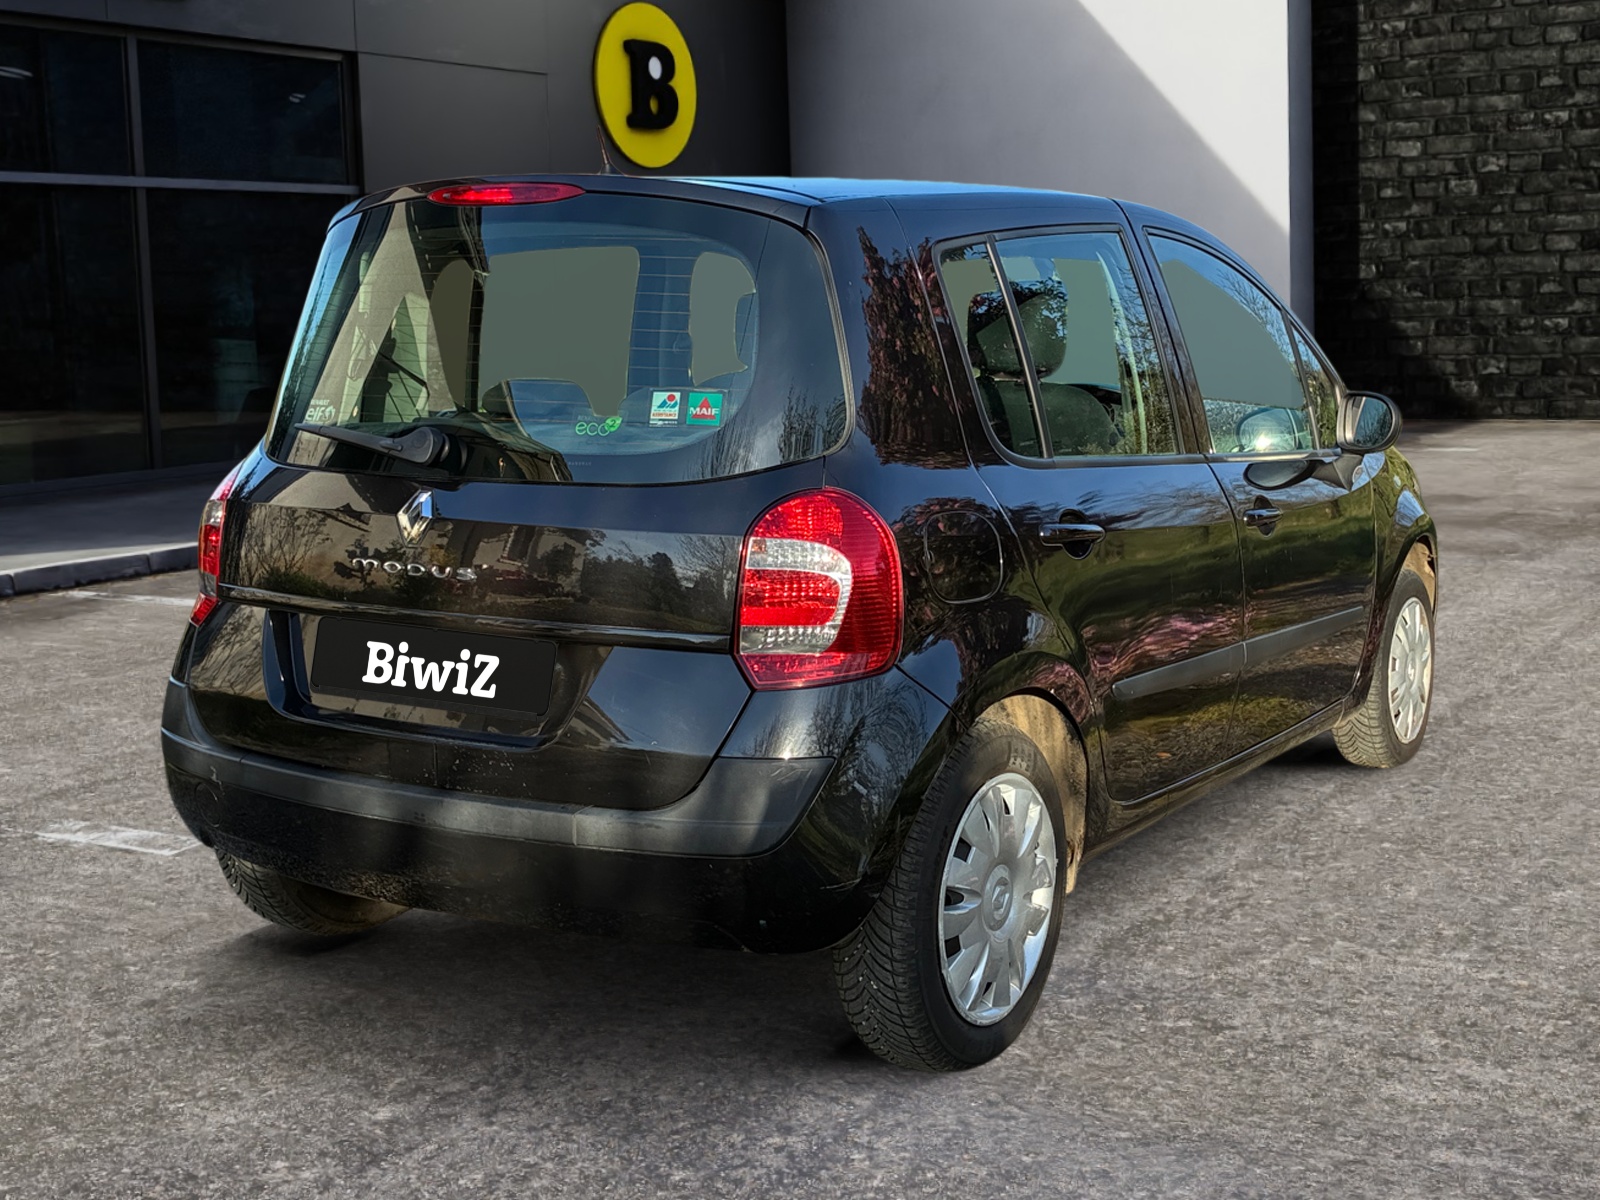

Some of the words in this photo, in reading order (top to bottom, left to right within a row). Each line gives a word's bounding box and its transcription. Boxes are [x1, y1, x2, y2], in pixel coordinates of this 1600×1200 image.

[622, 38, 679, 130] B
[689, 406, 720, 416] MAIF
[361, 640, 500, 699] BiwiZ
